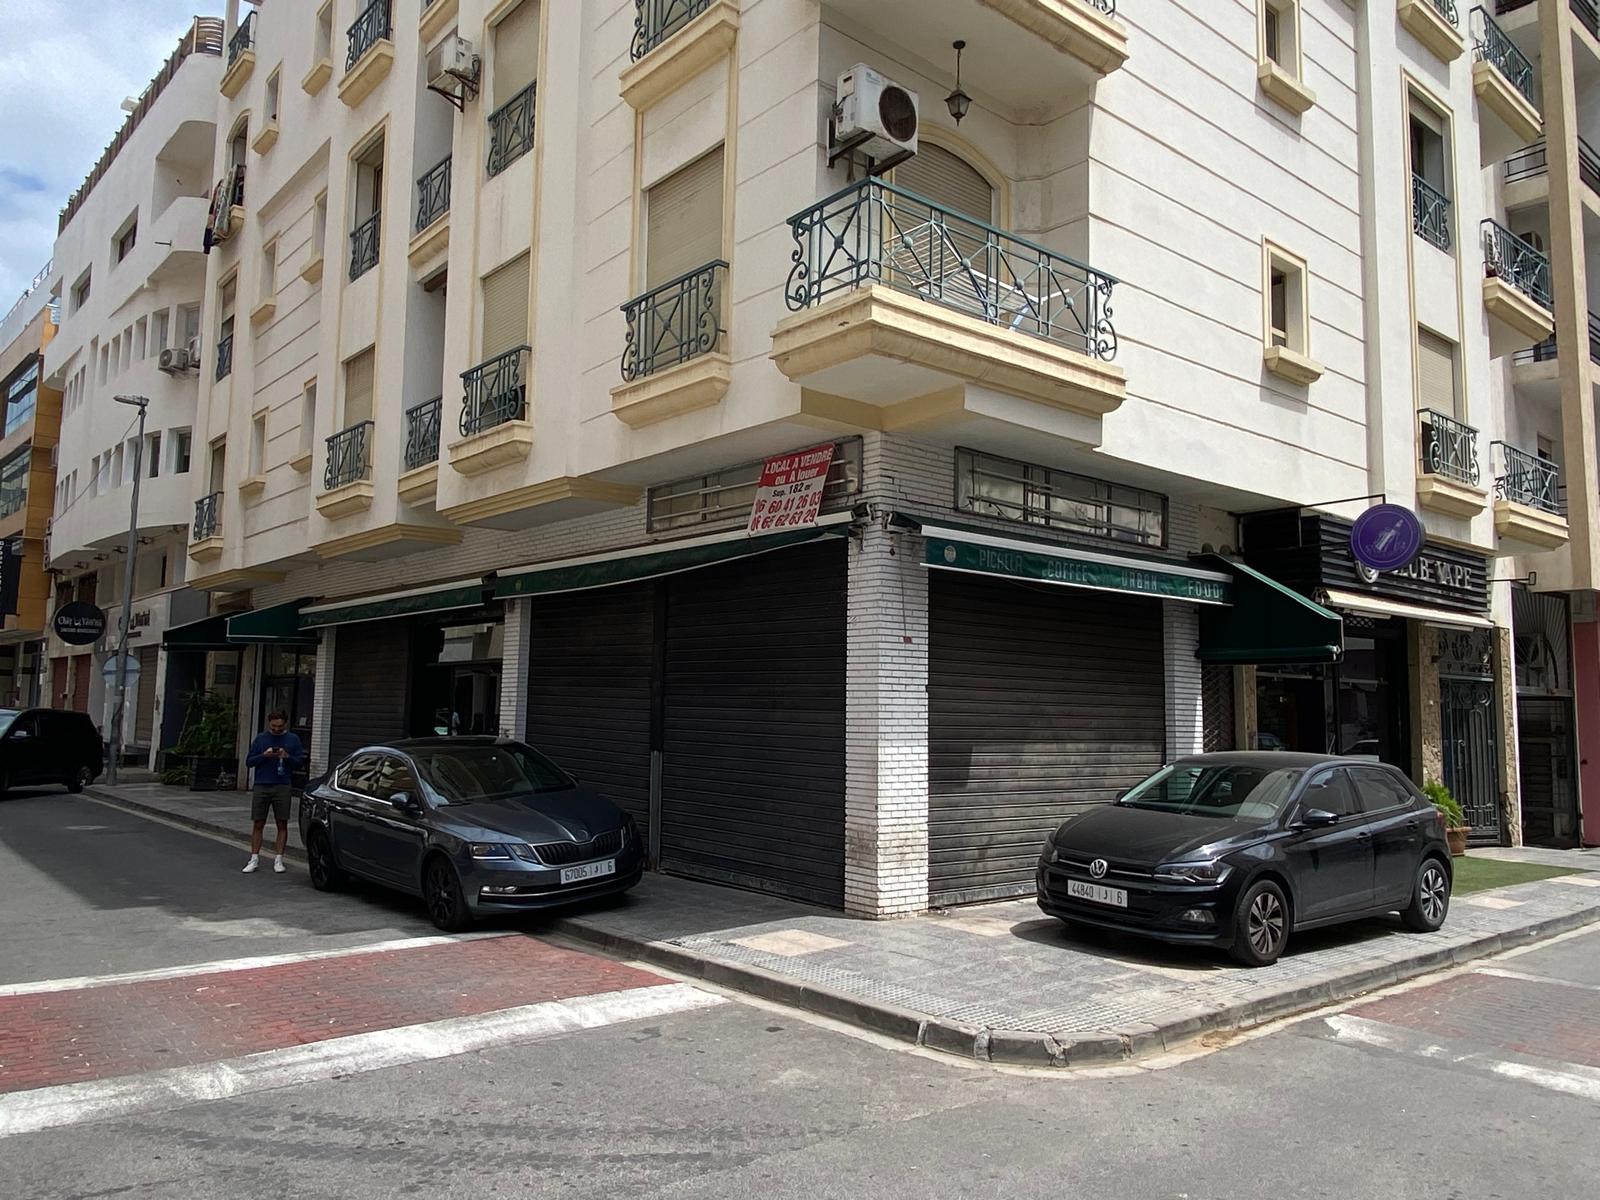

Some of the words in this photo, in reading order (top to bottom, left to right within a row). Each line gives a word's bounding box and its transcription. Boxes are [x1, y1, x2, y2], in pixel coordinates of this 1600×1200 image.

[765, 459, 790, 474] LOCAL
[800, 448, 834, 468] VENDRE
[774, 475, 786, 485] ou
[797, 467, 820, 481] louer
[789, 483, 804, 495] 182
[768, 499, 782, 514] 60
[809, 491, 822, 506] 03
[1047, 560, 1088, 582] COFFEE
[1121, 569, 1157, 591] URBAN
[1434, 560, 1472, 589] VAPE
[1116, 891, 1122, 904] 6
